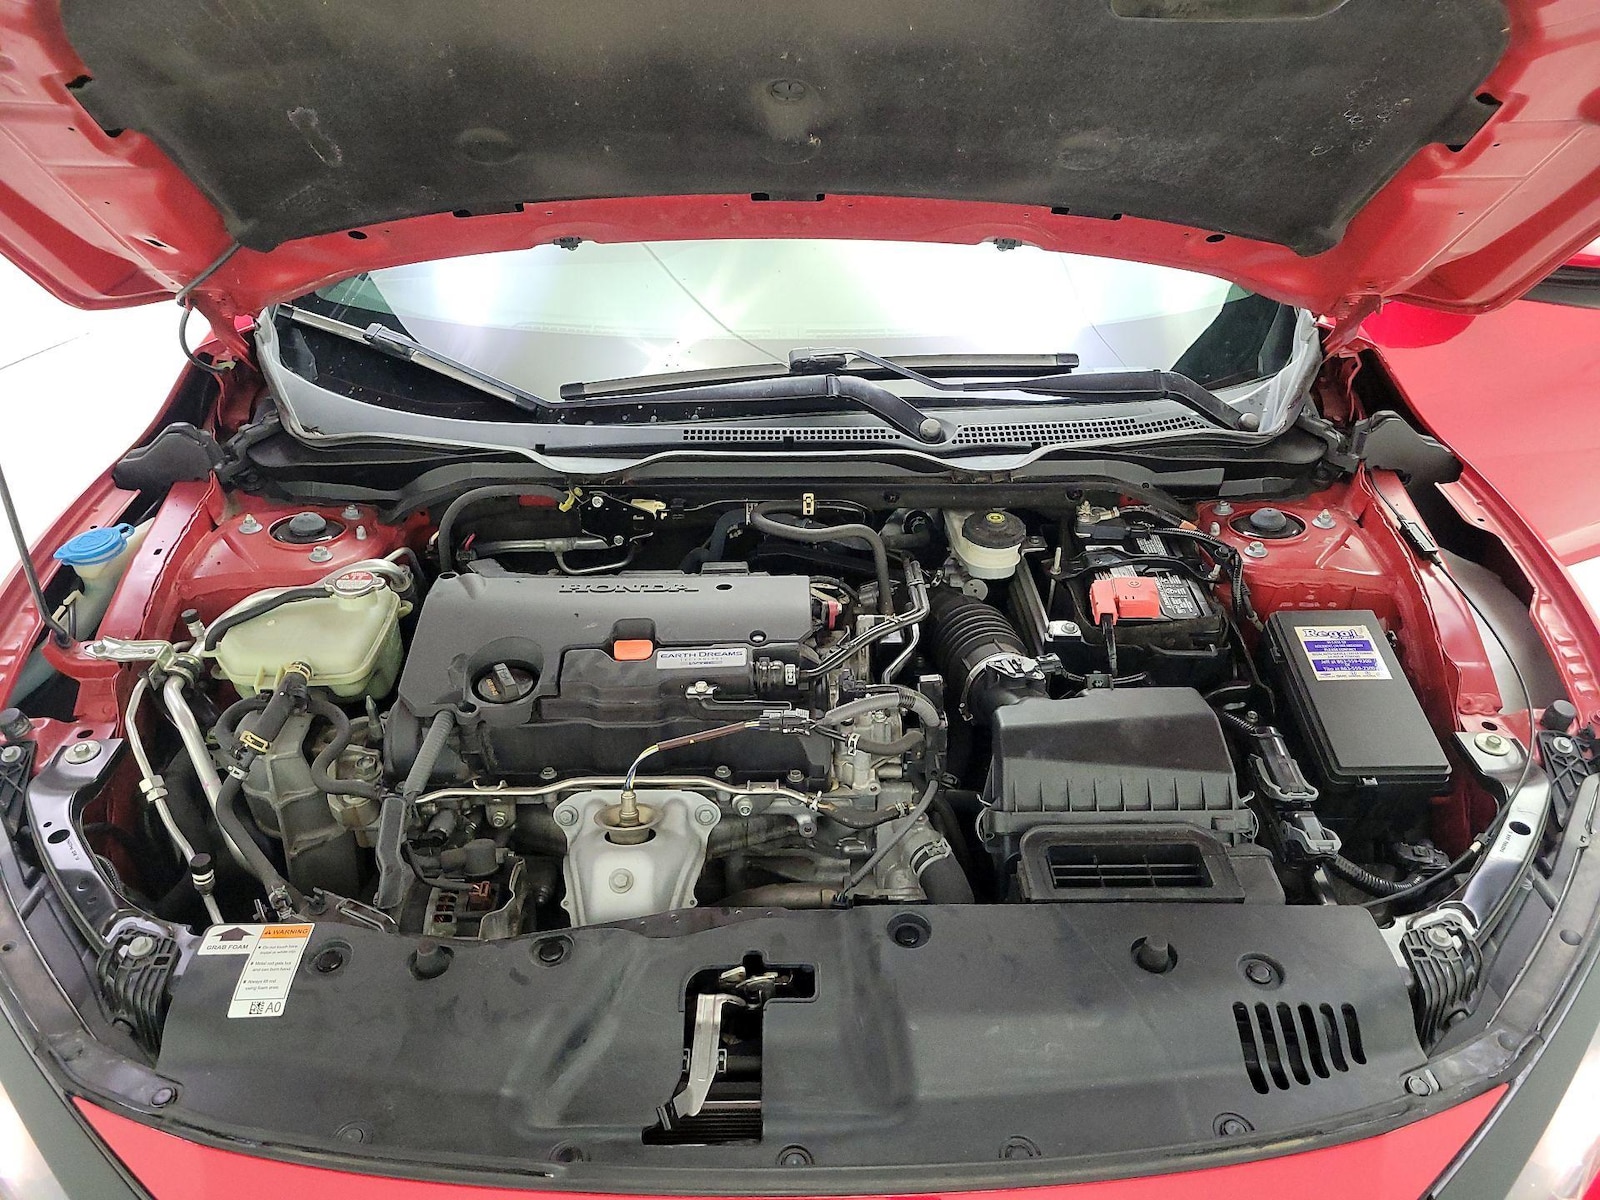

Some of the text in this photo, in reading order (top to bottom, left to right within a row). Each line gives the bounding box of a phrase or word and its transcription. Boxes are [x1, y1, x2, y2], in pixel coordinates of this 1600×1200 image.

[559, 584, 699, 593] HONDA
[1303, 629, 1358, 638] Regal
[265, 1001, 281, 1014] A0
